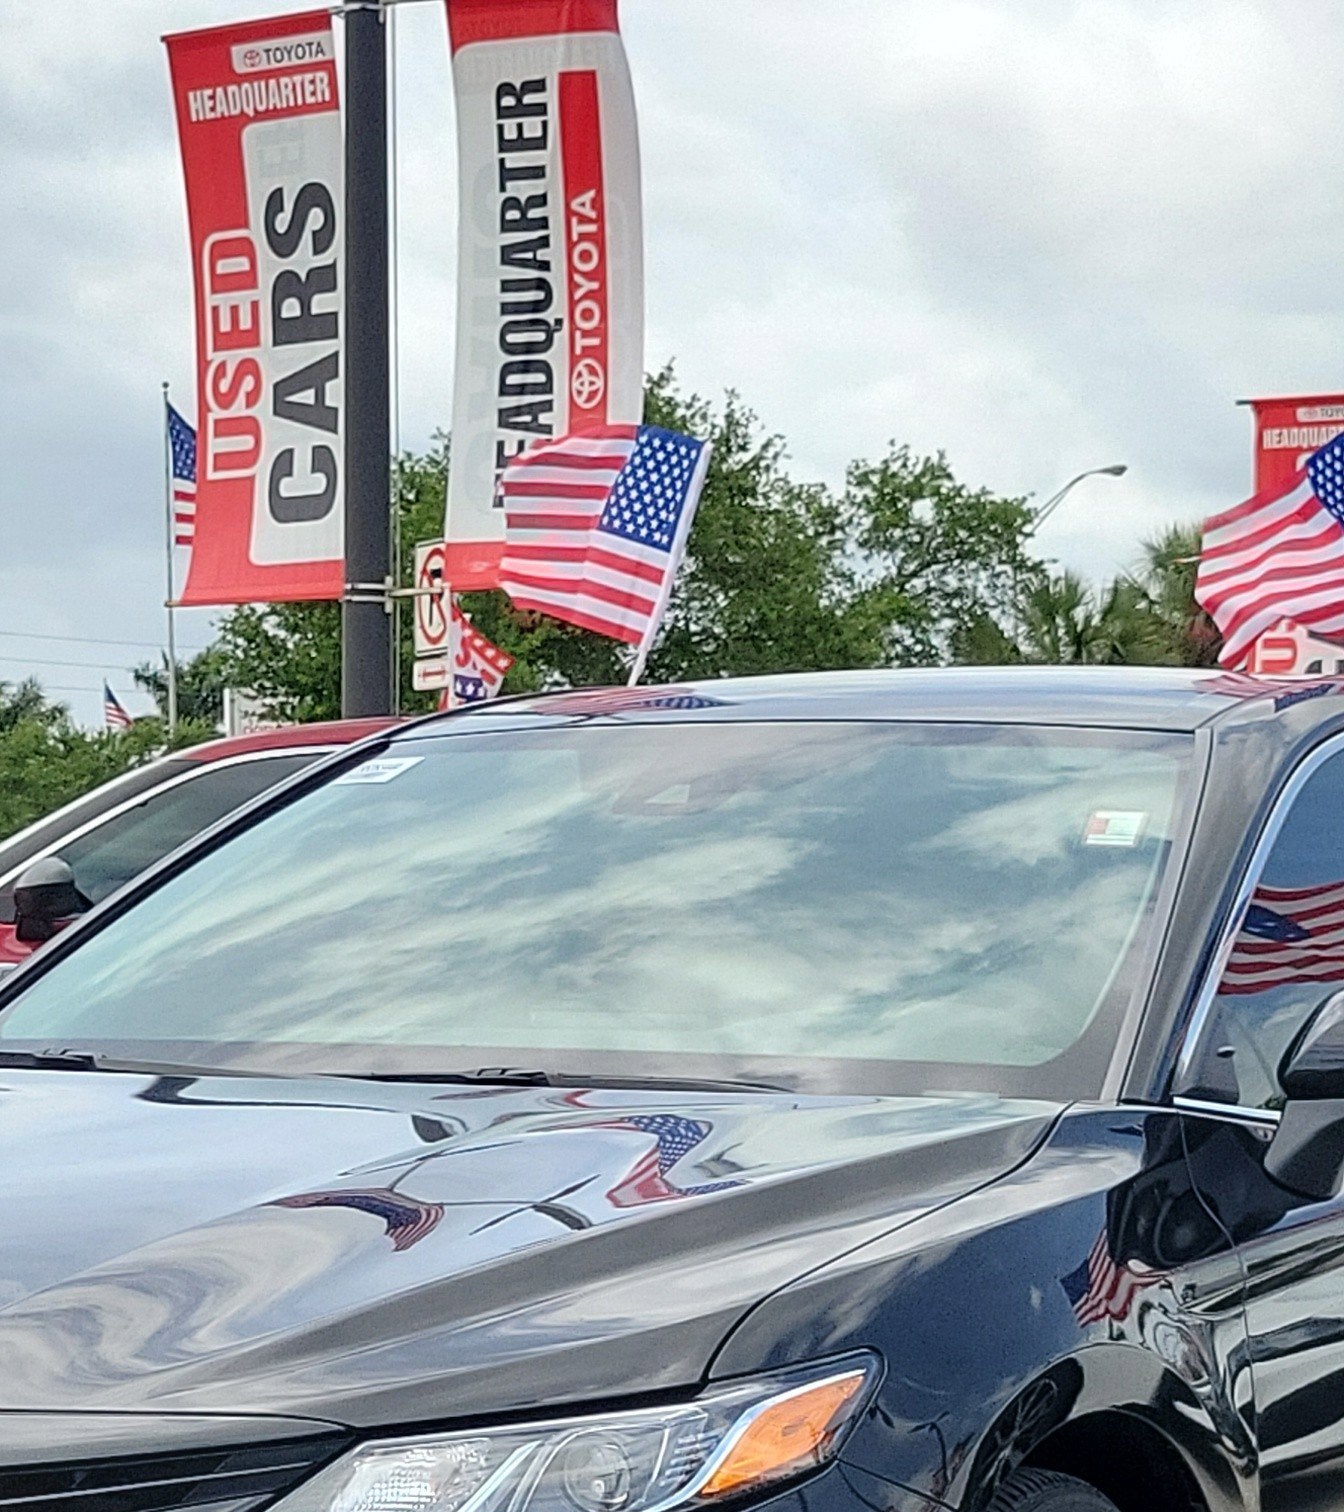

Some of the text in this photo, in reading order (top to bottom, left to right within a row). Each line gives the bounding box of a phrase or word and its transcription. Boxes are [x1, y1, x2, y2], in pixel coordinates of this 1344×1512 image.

[188, 72, 330, 121] HEADQUARTER
[263, 42, 325, 65] TOYOTA
[207, 233, 263, 474] USED
[264, 181, 339, 524] CARS
[493, 77, 563, 507] EADQUARTER
[571, 188, 601, 355] TOYOTA
